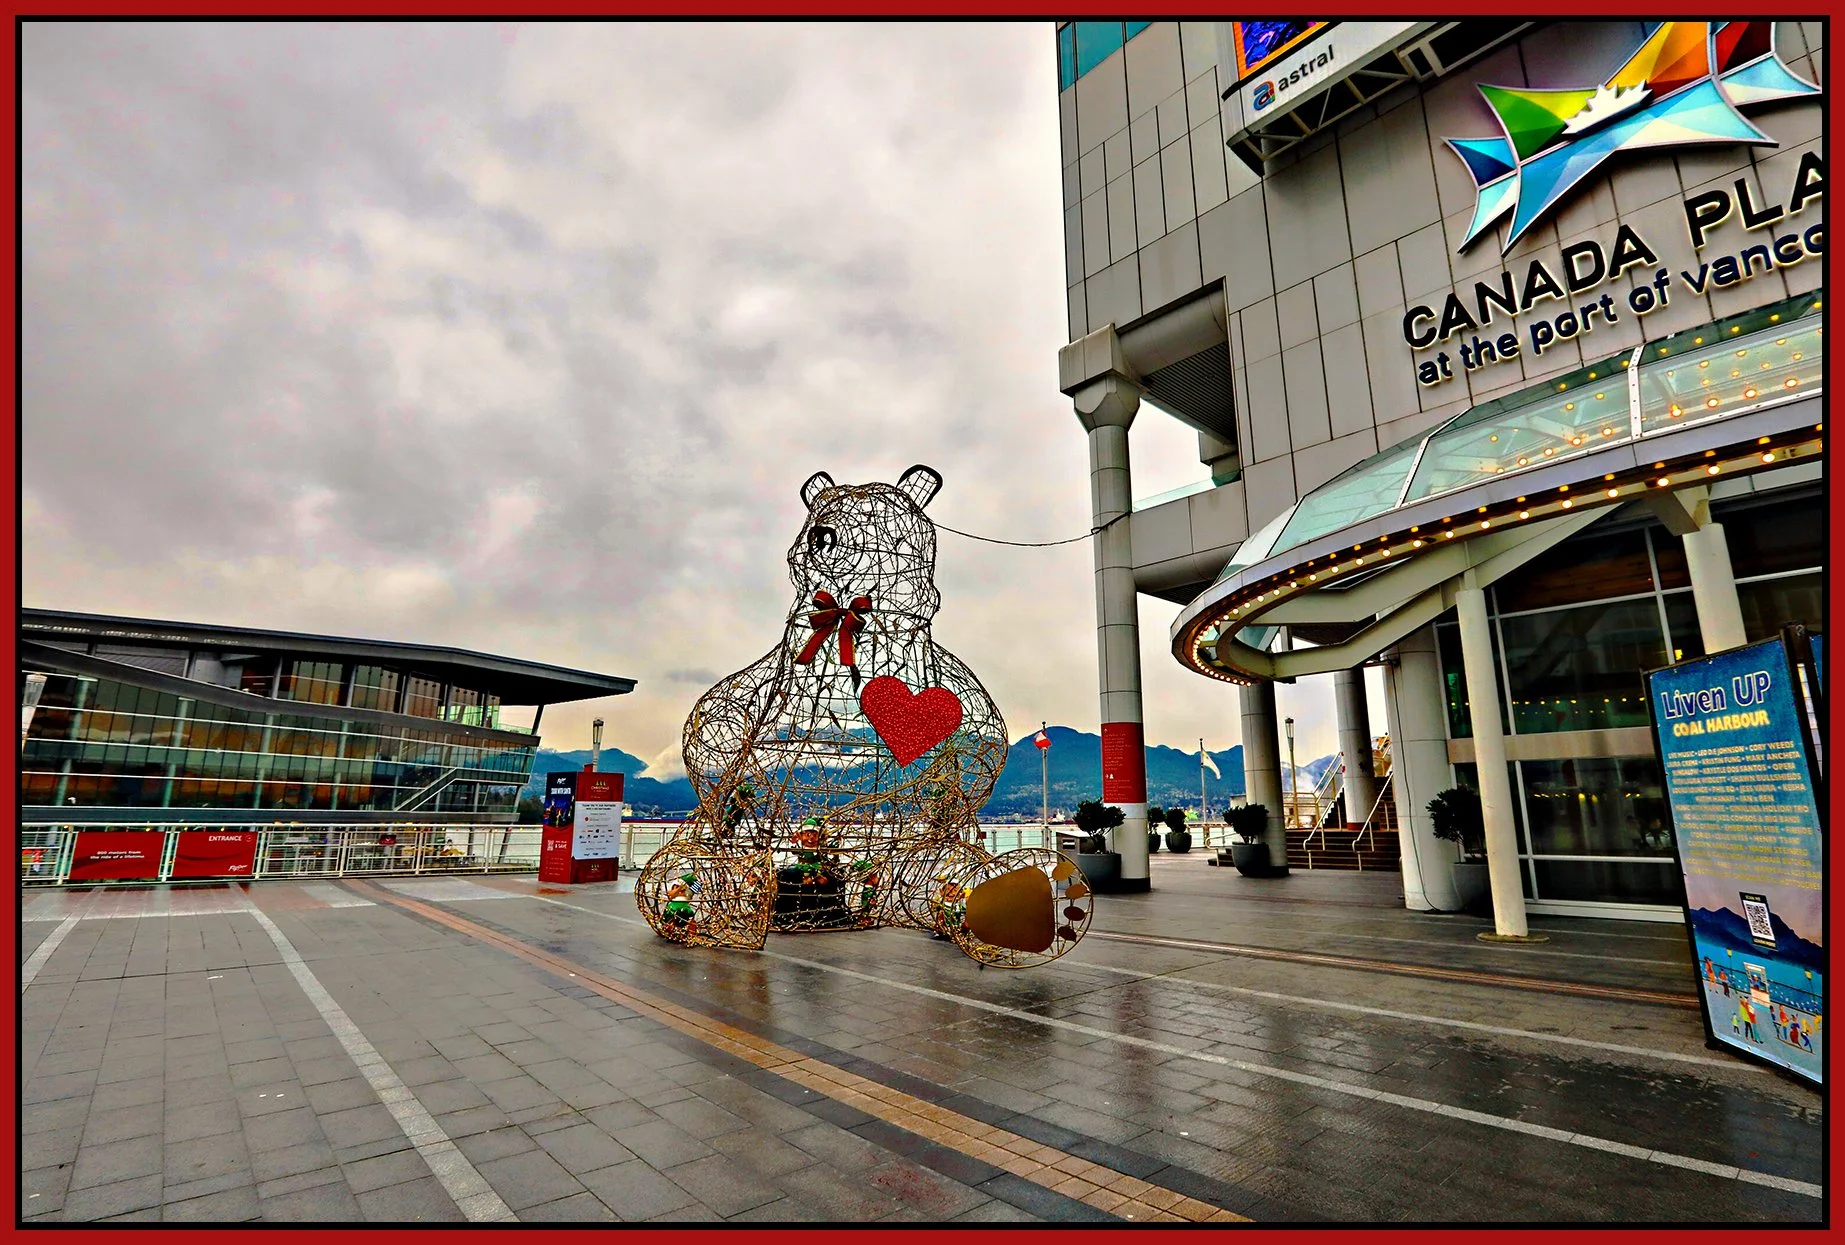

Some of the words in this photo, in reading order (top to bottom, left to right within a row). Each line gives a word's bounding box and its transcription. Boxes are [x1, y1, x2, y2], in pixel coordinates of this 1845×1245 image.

[1278, 44, 1335, 92] astral
[1403, 224, 1658, 348] CANADA
[1684, 151, 1822, 249] PLA
[1418, 352, 1453, 386] at
[1460, 332, 1521, 370] the
[1530, 294, 1619, 355] port
[1629, 268, 1671, 314] of
[1661, 686, 1727, 719] Liven
[1732, 670, 1771, 706] UP
[1673, 720, 1705, 737] COAL
[1706, 709, 1770, 733] HARBOUR
[1717, 745, 1745, 755] JOHNSON
[1749, 743, 1766, 751] CORY
[1767, 740, 1794, 750] WEEDS
[1745, 754, 1764, 762] MARY
[1767, 750, 1801, 760] ANCHETA
[1740, 764, 1767, 773] SANTOS
